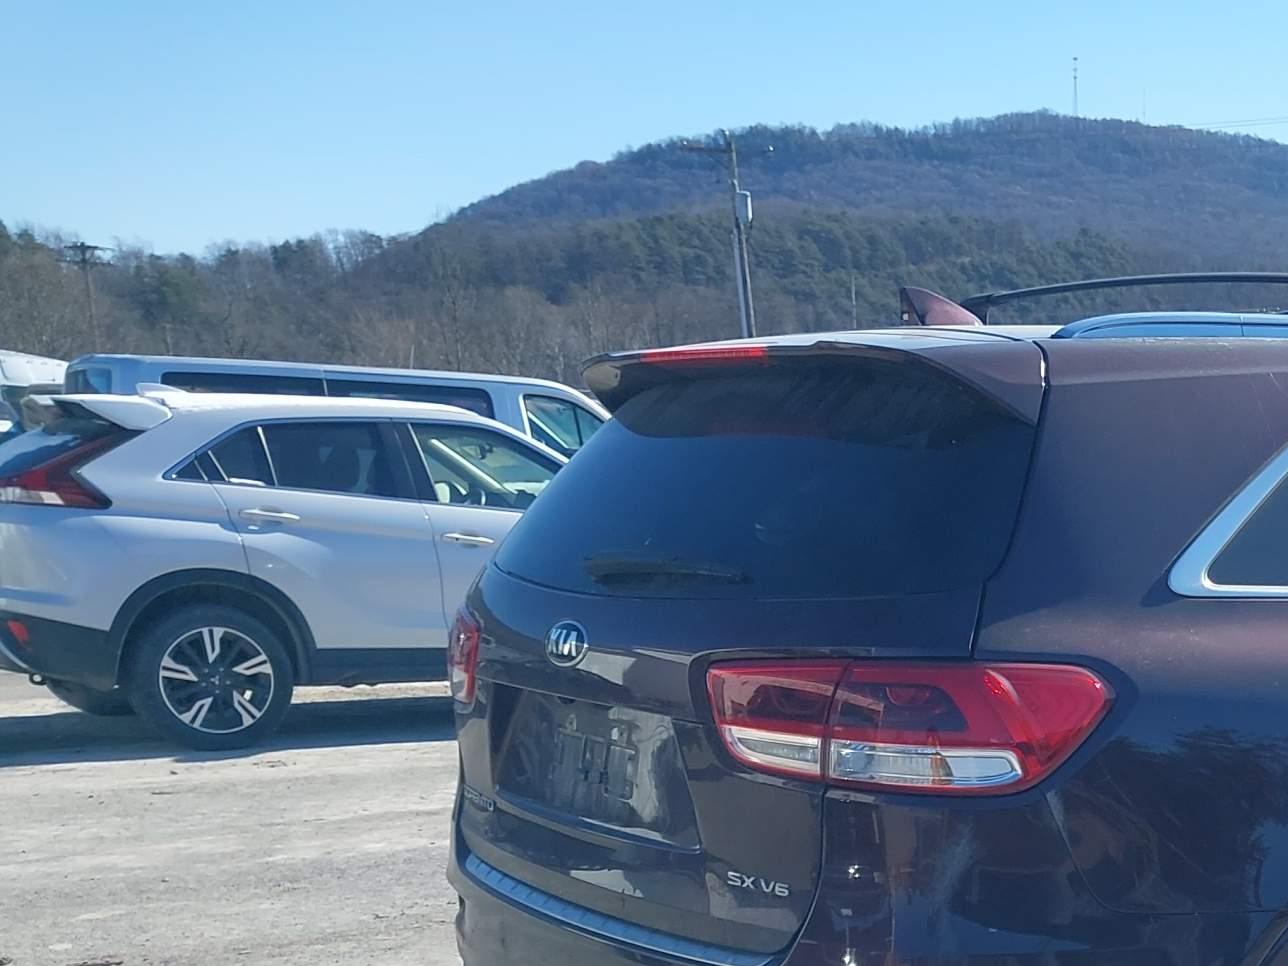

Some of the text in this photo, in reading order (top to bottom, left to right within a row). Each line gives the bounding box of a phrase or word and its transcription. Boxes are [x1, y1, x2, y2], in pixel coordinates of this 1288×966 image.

[549, 628, 577, 656] KIA
[727, 871, 789, 897] SX V6
